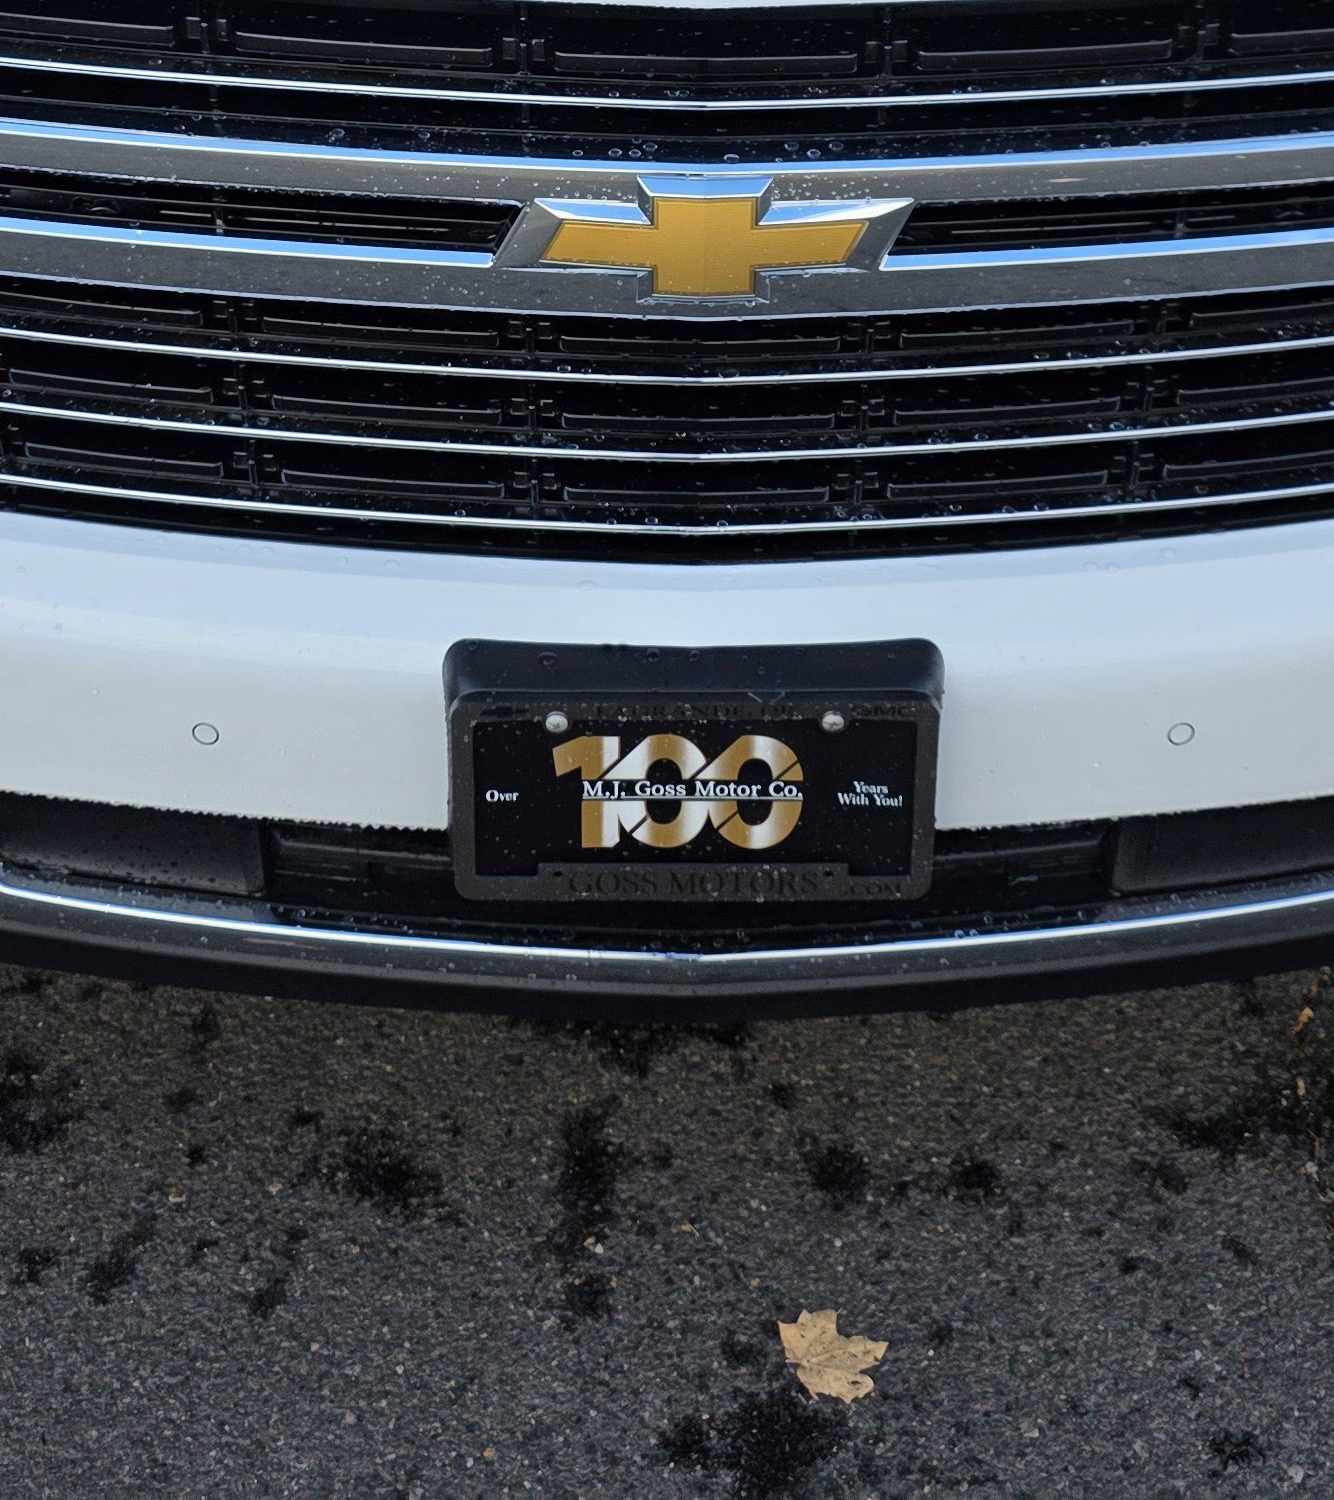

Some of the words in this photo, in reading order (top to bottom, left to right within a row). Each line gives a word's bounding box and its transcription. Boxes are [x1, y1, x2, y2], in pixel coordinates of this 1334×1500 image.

[552, 734, 804, 849] 100
[582, 780, 626, 799] M.J.
[634, 780, 687, 797] Goss
[695, 780, 762, 797] Motor
[768, 780, 803, 798] Co.
[853, 780, 889, 794] Years
[485, 789, 519, 803] Over
[837, 792, 870, 806] With
[873, 793, 903, 807] You!
[568, 870, 658, 896] GOSS
[669, 870, 819, 896] MOTORS
